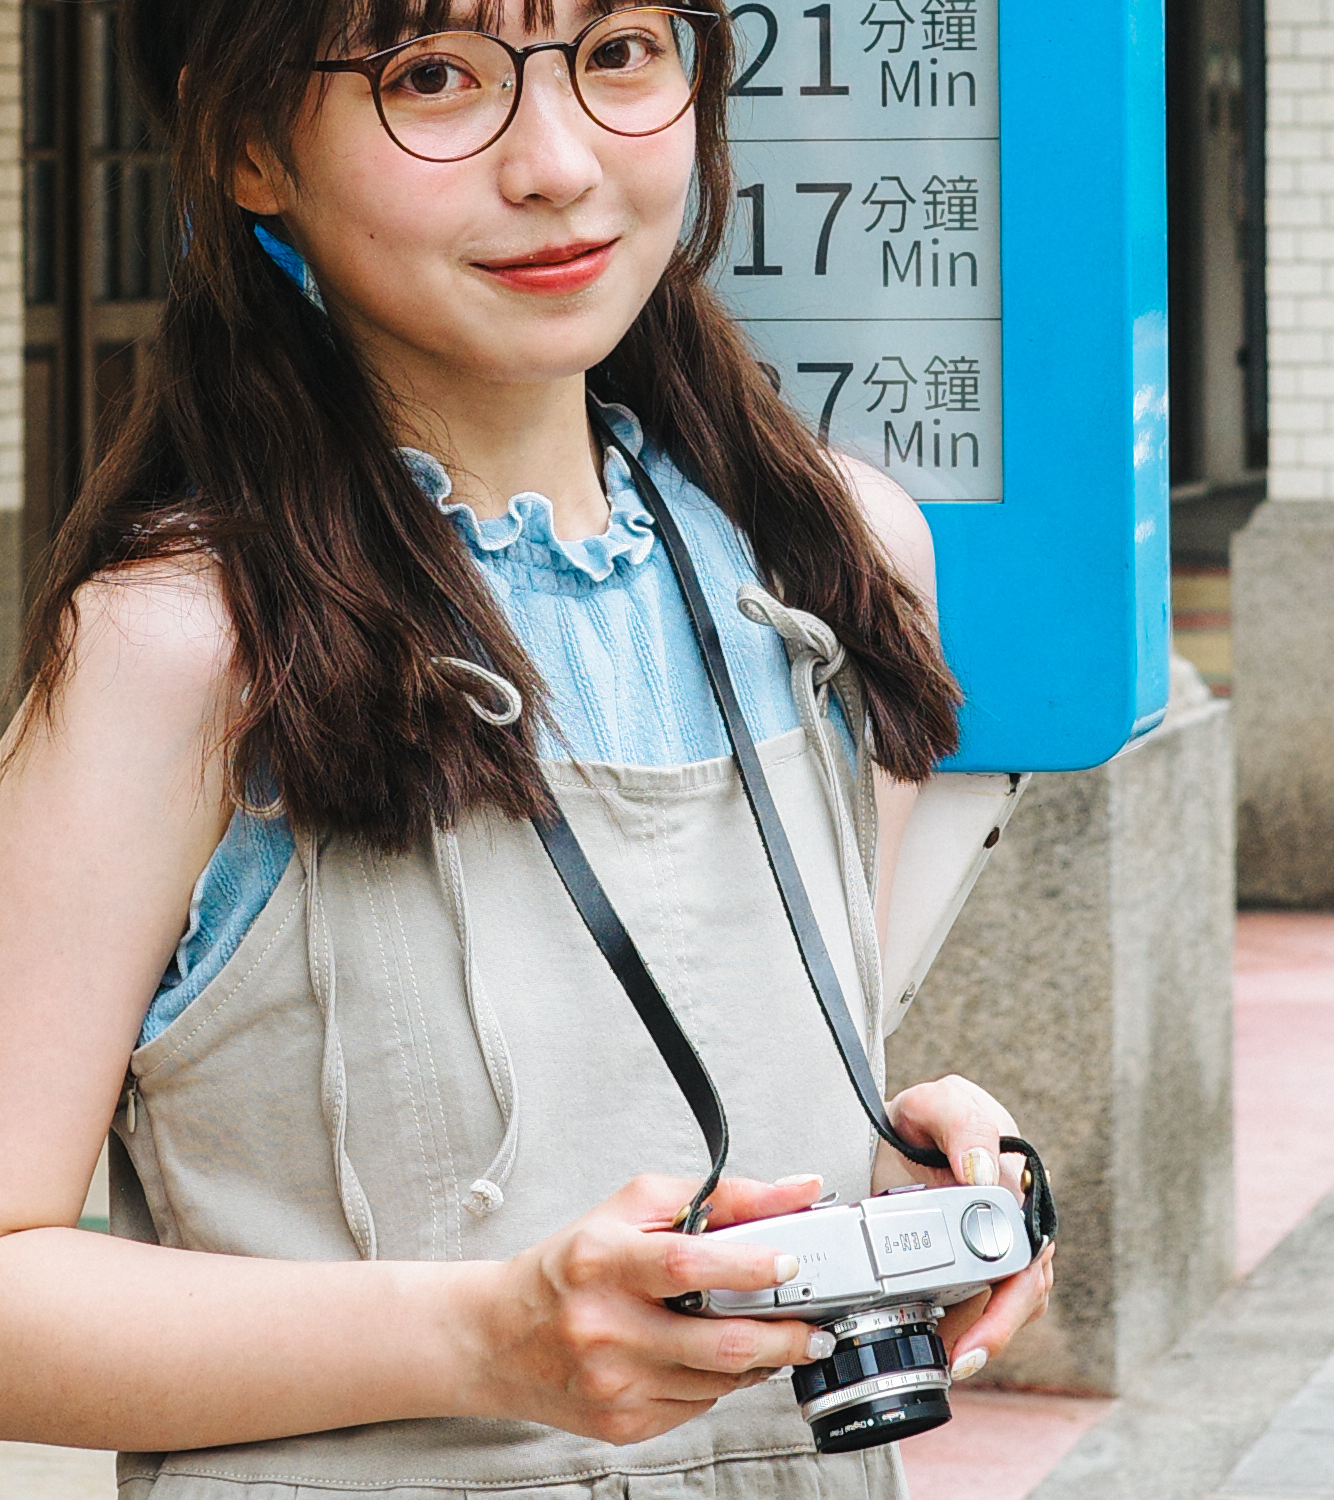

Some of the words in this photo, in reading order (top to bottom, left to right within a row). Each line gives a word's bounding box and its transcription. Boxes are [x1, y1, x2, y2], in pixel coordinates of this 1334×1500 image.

[727, 2, 850, 97] 21
[881, 57, 976, 108] Min
[733, 182, 853, 276] 17
[861, 174, 979, 234] 分鐘
[882, 237, 978, 288] Min
[863, 354, 981, 414] 分鐘
[883, 417, 979, 468] Min
[884, 1230, 931, 1254] PEN-F
